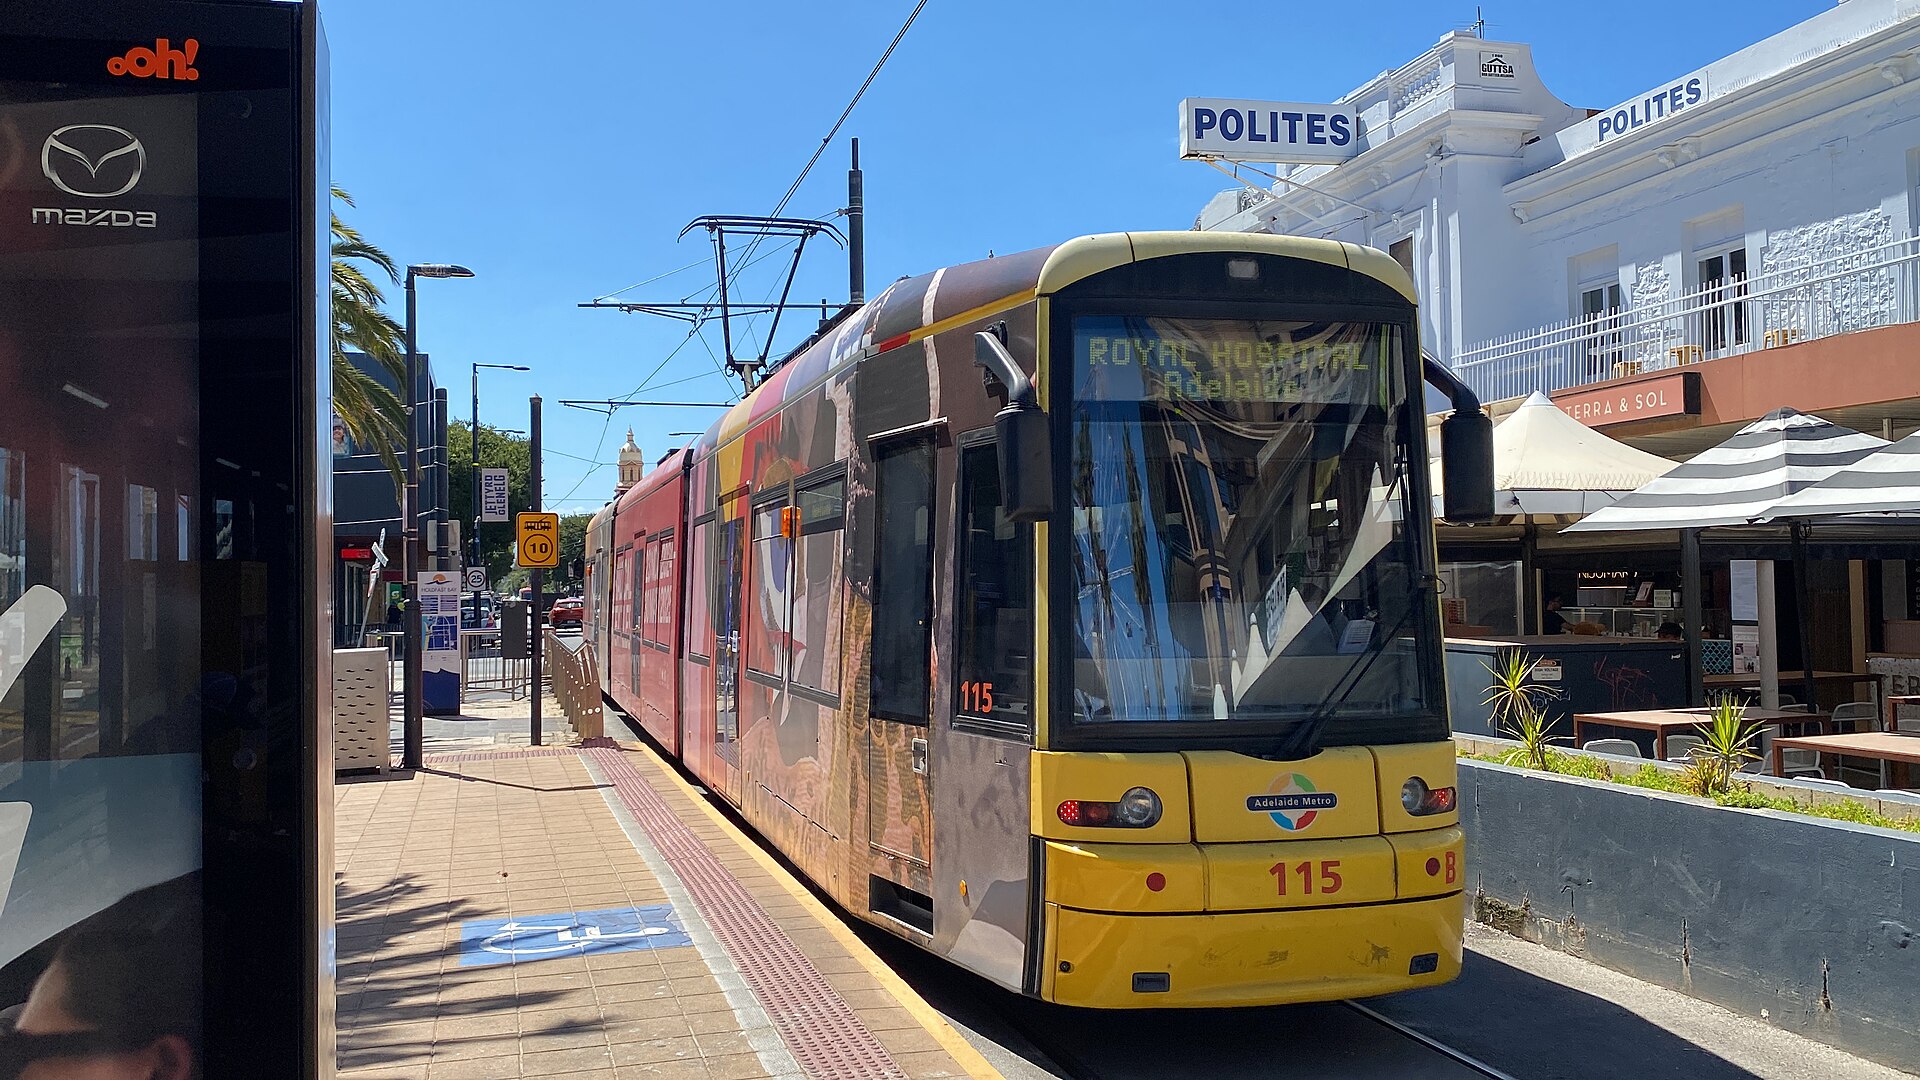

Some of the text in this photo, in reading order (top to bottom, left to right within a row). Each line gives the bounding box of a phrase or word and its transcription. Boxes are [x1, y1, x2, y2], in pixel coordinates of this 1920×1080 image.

[1481, 63, 1514, 74] GUTTSA
[1598, 78, 1702, 142] POLITES
[1194, 108, 1351, 146] POLITES
[1089, 337, 1369, 370] ROYAL HOSPITAL
[1164, 370, 1299, 399] Adelaide
[1565, 389, 1667, 420] TERRA & SOL
[493, 474, 506, 516] GLENELG
[529, 542, 549, 554] 10
[470, 574, 483, 584] 25
[961, 680, 993, 713] 115
[1254, 797, 1331, 808] Adelaide Metro
[1269, 860, 1343, 896] 115
[1445, 851, 1456, 884] B
